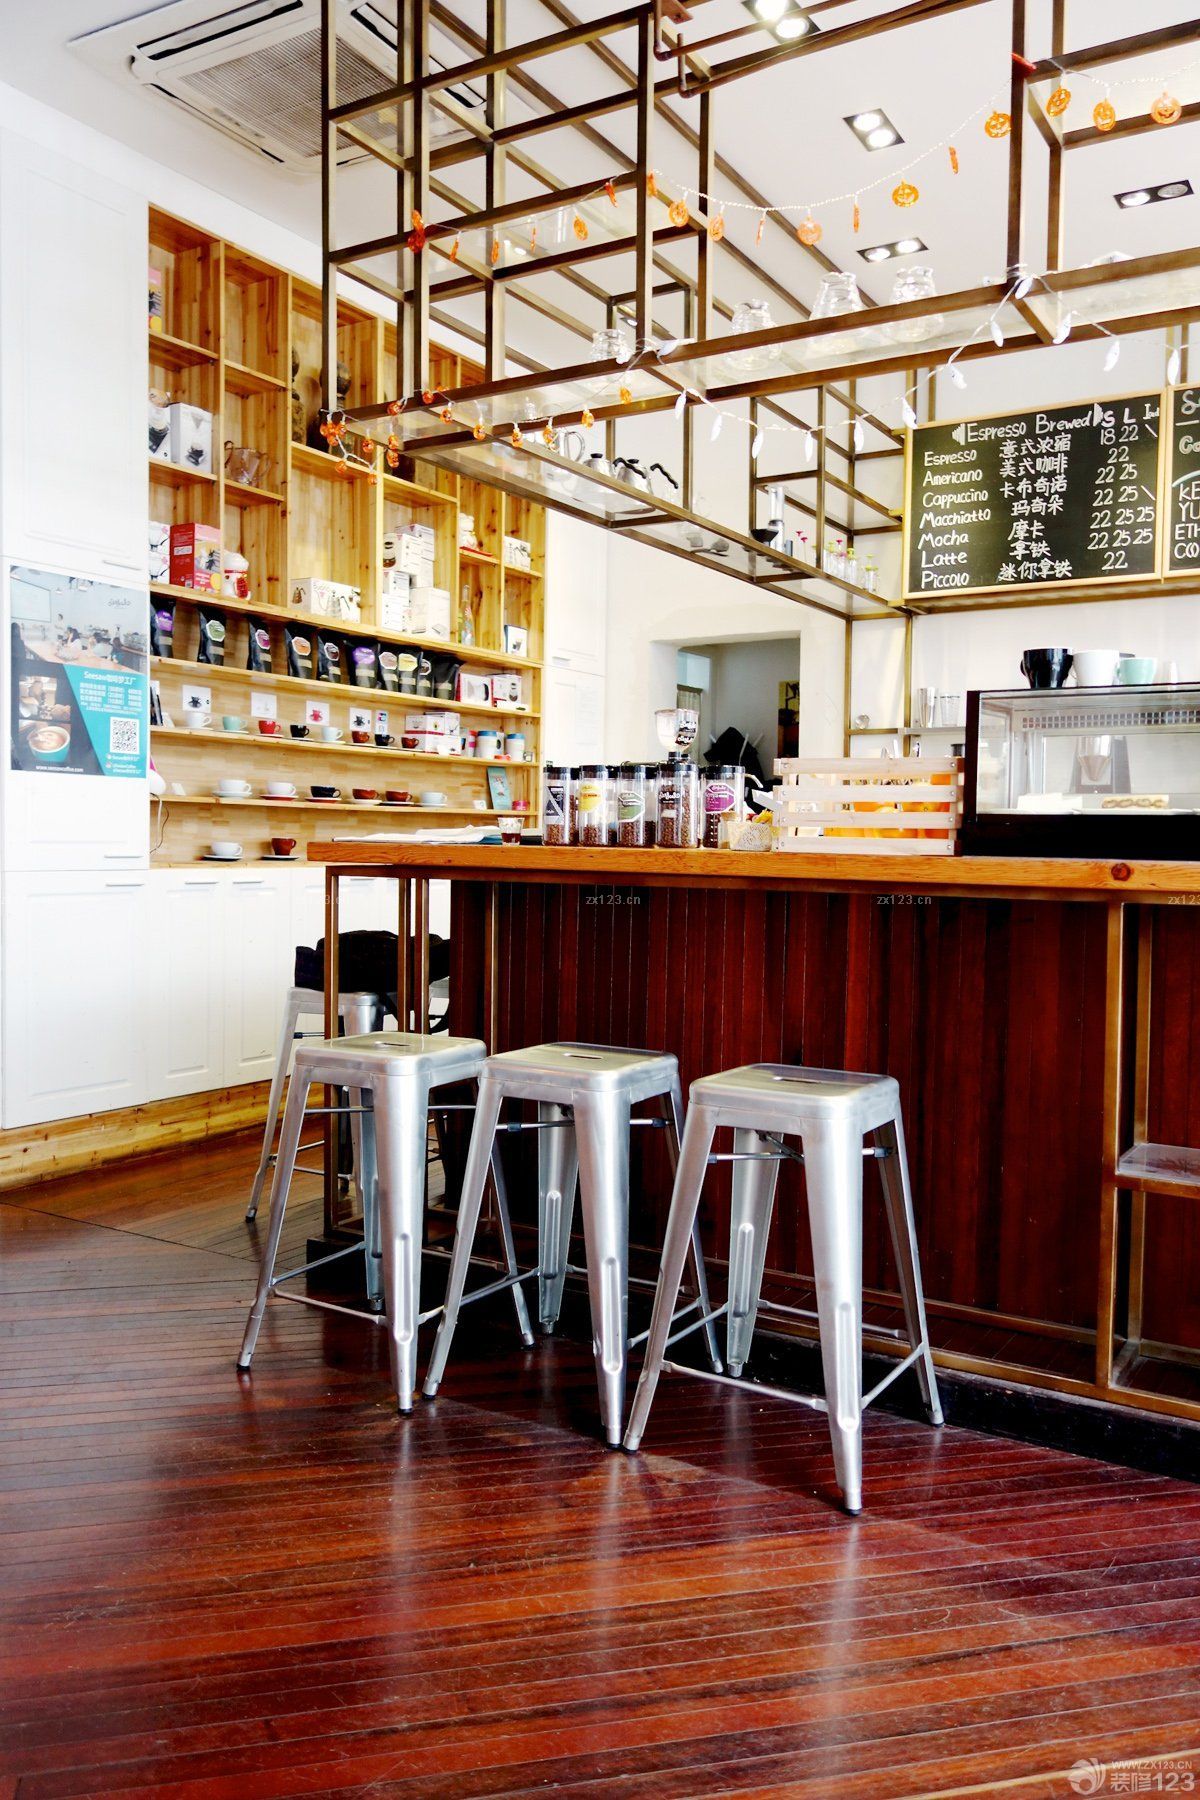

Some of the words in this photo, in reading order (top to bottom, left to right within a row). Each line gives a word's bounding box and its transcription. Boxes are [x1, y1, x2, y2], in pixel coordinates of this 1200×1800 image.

[967, 422, 1027, 443] Espresso
[1035, 411, 1092, 435] Brewed
[1101, 410, 1116, 427] S
[1123, 407, 1136, 424] L
[999, 432, 1072, 458] 意式浓缩
[1100, 428, 1116, 445] 18
[1119, 424, 1139, 443] 22
[924, 450, 977, 467] Espresso
[999, 453, 1069, 478] 美式咖啡
[1107, 445, 1130, 464] 22
[922, 469, 983, 487] Americano
[1094, 466, 1115, 485] 22
[1119, 463, 1138, 480] 25
[999, 474, 1068, 499] 卡布奇诺
[1092, 488, 1114, 507] 22
[1118, 485, 1139, 503] 25
[922, 489, 989, 509] Cappuccino
[1011, 495, 1064, 517] 玛奇朵
[919, 508, 991, 530] Macchiatto
[1090, 509, 1112, 529] 22
[1115, 508, 1135, 526] 25
[1136, 506, 1155, 523] 25
[917, 530, 969, 550] Mocha
[1007, 519, 1046, 541] 摩卡
[1087, 532, 1109, 550] 22
[1112, 529, 1131, 547] 25
[1132, 528, 1153, 545] 25
[921, 550, 968, 569] Latte
[1009, 540, 1052, 561] 拿铁
[1101, 550, 1128, 571] 22
[920, 571, 970, 590] Piccolo
[998, 558, 1073, 581] 迷你拿铁
